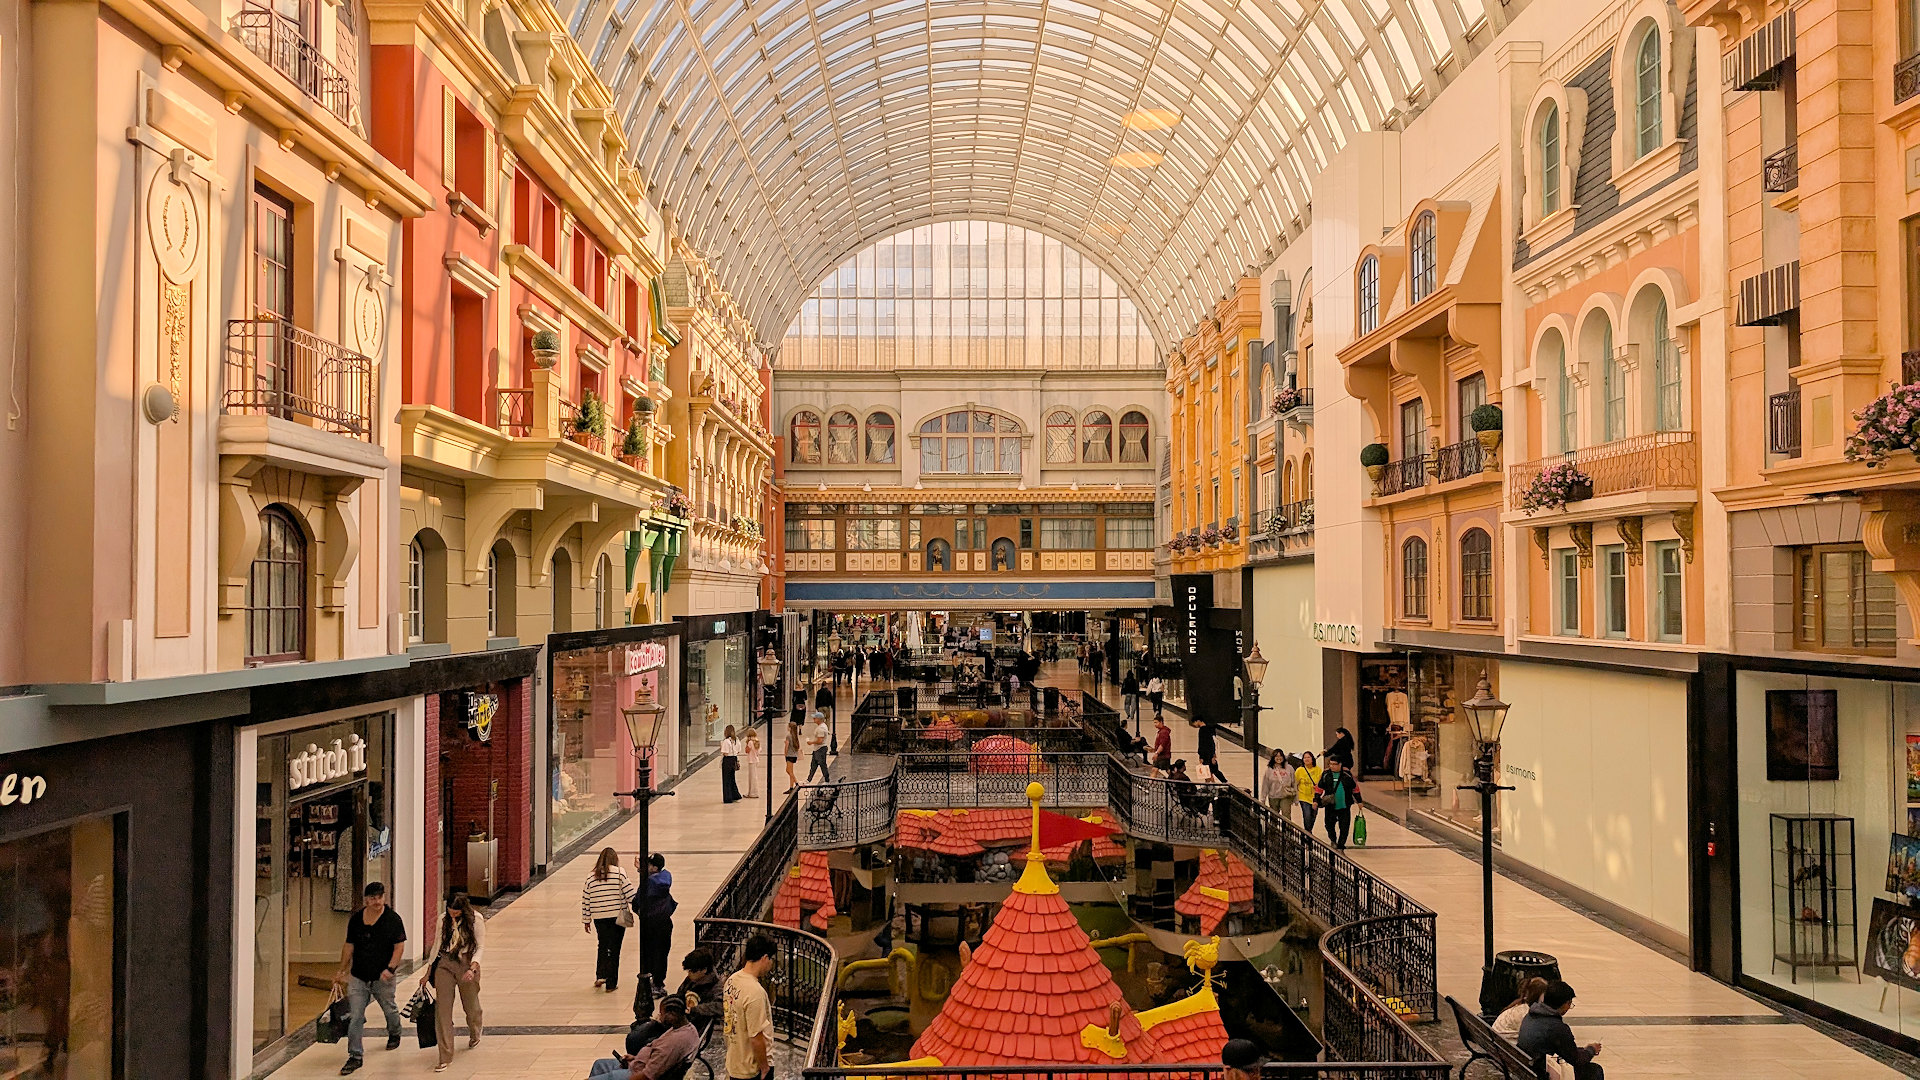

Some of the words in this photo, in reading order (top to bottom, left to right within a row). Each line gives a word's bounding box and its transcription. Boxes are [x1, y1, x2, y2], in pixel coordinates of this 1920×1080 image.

[1188, 586, 1197, 654] OPULENCE
[1318, 622, 1357, 645] simons
[290, 743, 349, 790] stitch
[349, 733, 367, 772] it
[1509, 765, 1536, 781] simons
